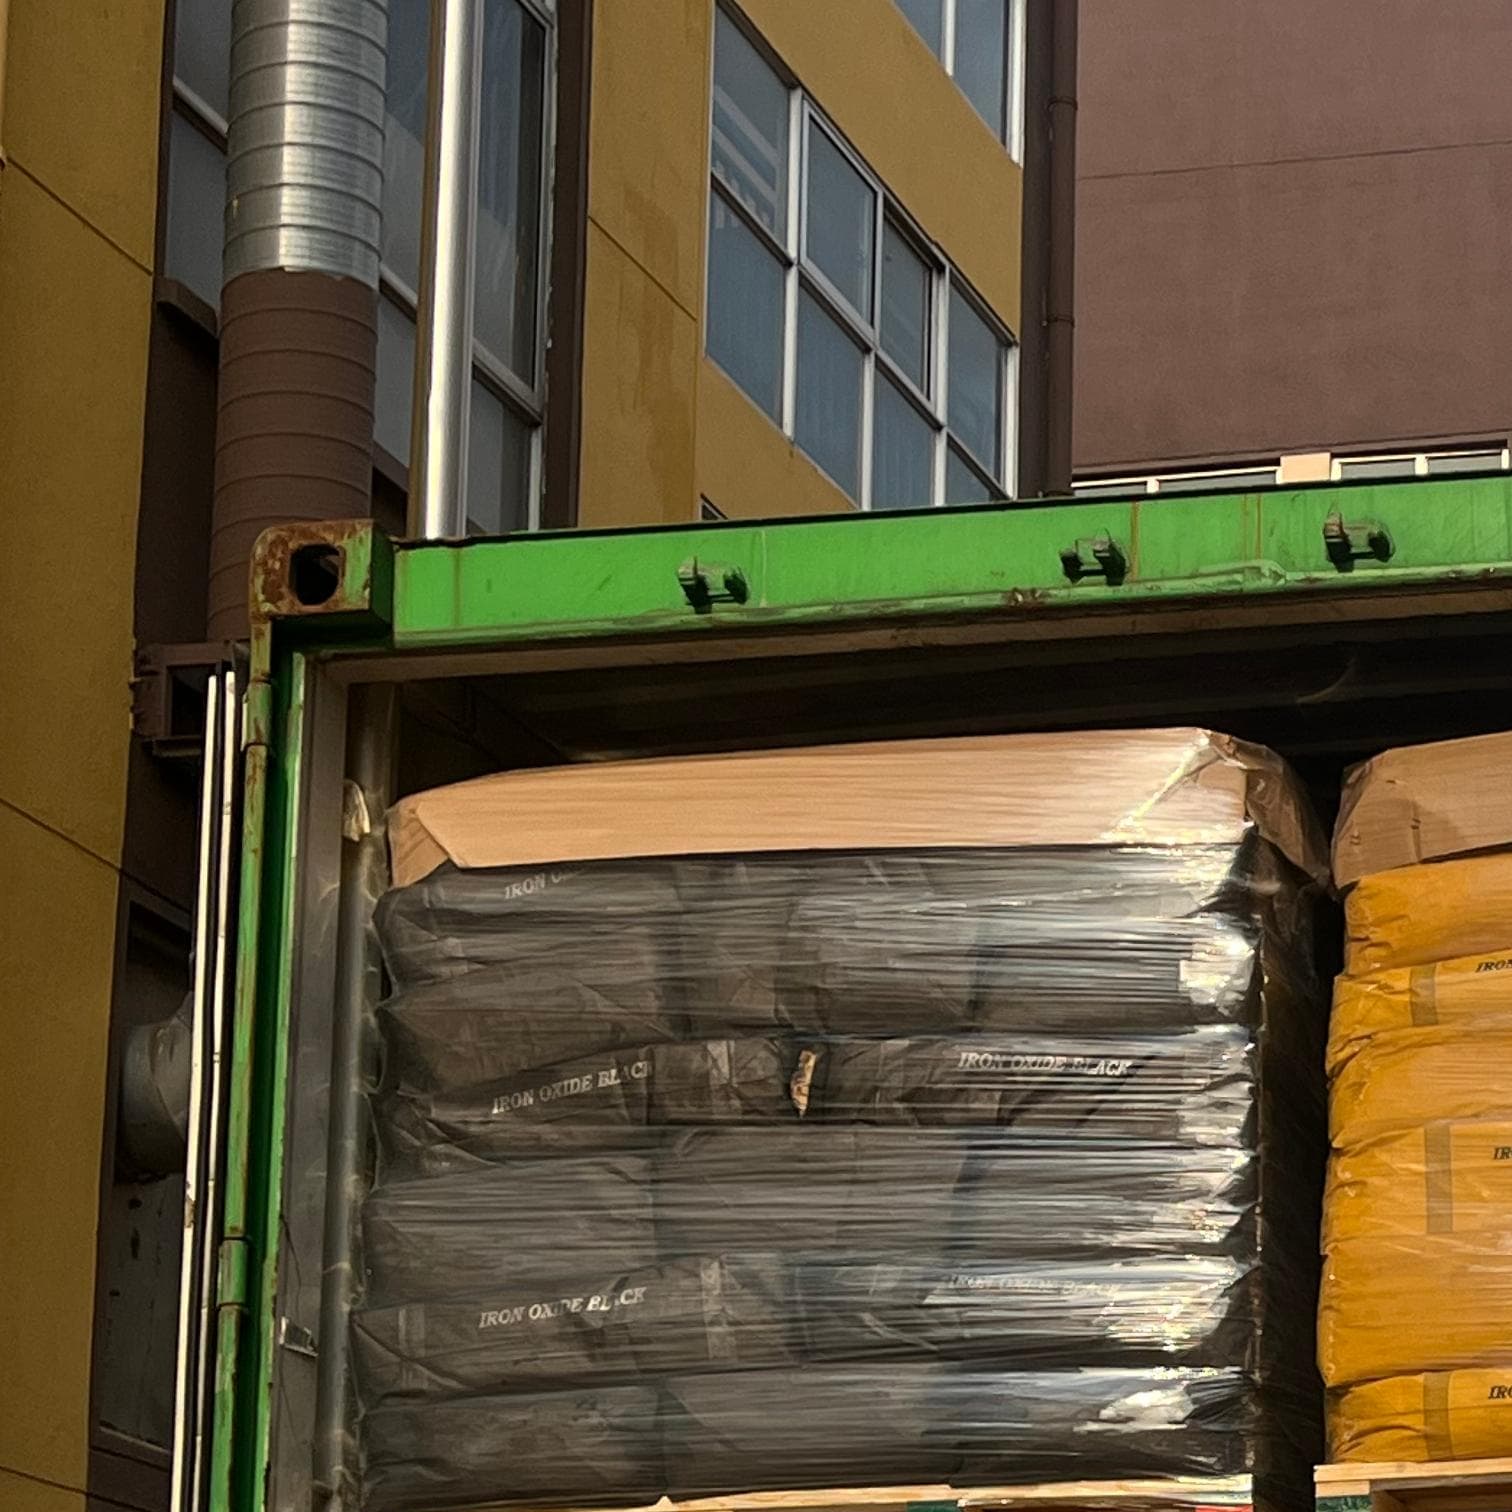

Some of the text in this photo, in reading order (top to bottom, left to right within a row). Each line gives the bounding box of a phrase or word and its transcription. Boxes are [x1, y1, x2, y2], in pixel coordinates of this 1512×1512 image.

[491, 1090, 534, 1114] IRON
[539, 1075, 593, 1102] OXIDE
[478, 1306, 526, 1329] IRON
[528, 1298, 584, 1320] OXIDE
